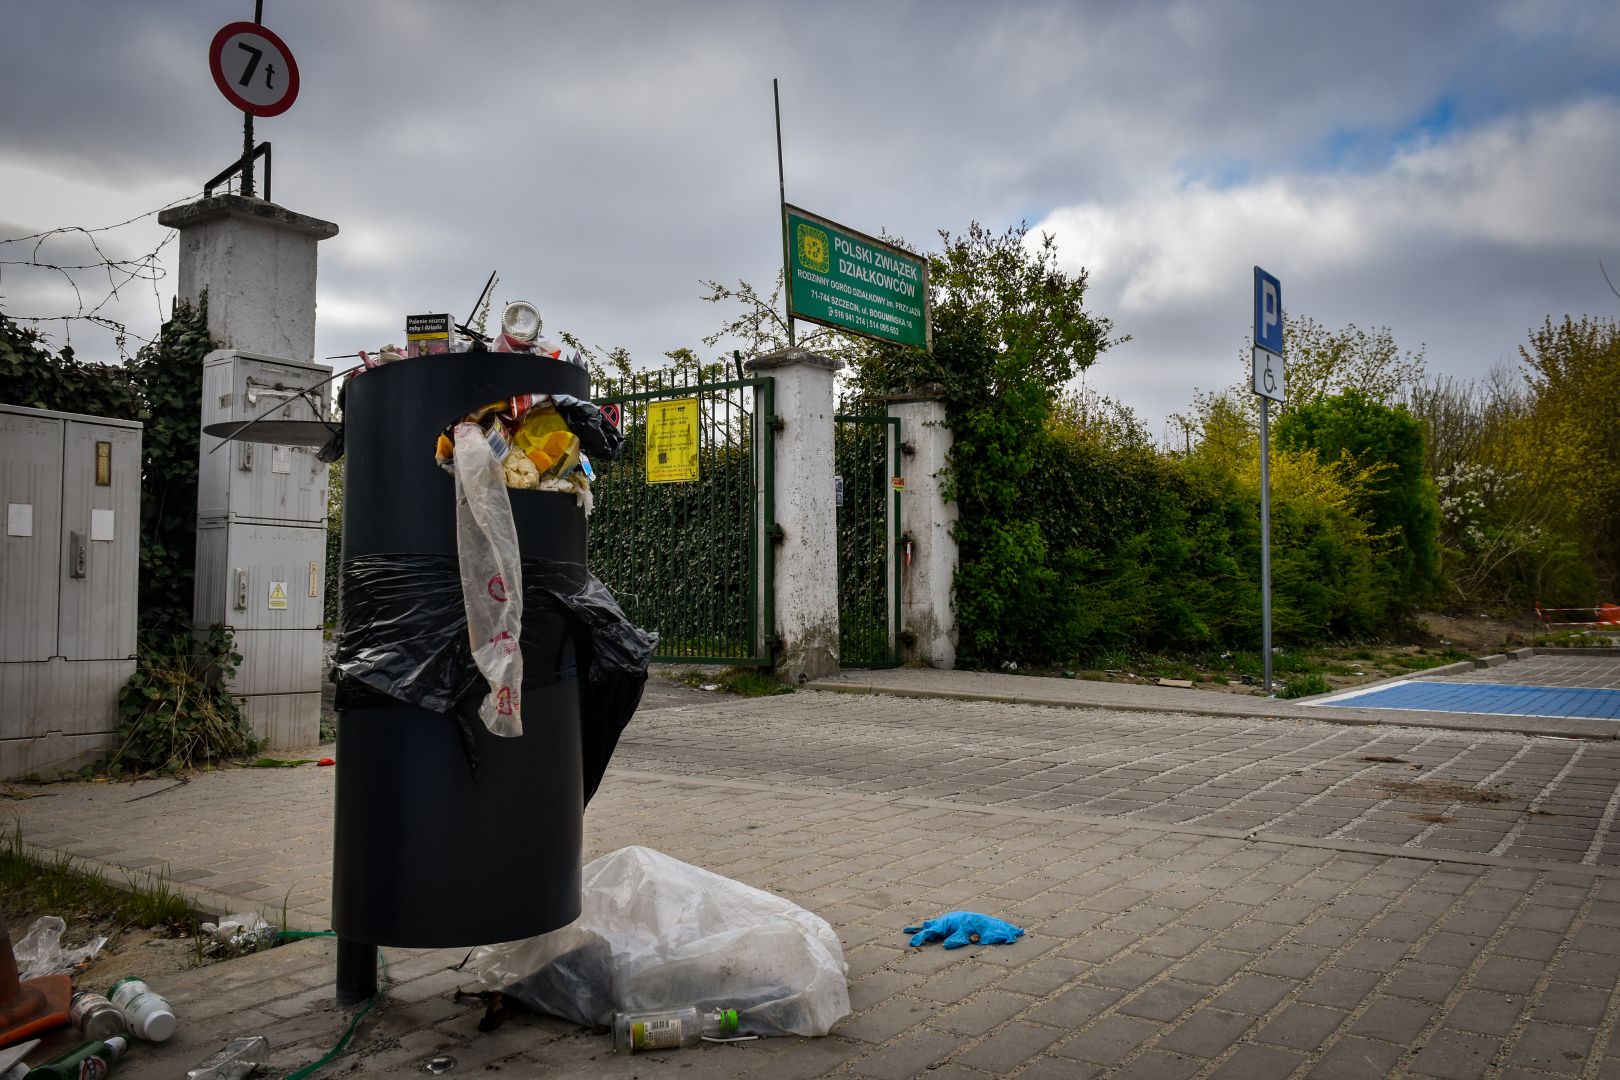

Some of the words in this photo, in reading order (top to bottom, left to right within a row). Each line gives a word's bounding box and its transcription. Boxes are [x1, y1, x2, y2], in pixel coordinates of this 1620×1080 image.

[834, 237, 872, 264] POLSKI
[874, 252, 918, 281] ZWIĄZEK
[797, 269, 830, 287] RODZINNY
[830, 280, 852, 295] OGRÓD
[852, 287, 886, 307] DZIAŁKOWY
[811, 289, 830, 303] 71-744
[840, 259, 915, 298] DZIAŁKOWCÓW
[834, 308, 845, 319] 516
[845, 312, 855, 323] 941
[855, 315, 866, 326] 214
[869, 319, 879, 330] 514
[1262, 279, 1278, 339] P
